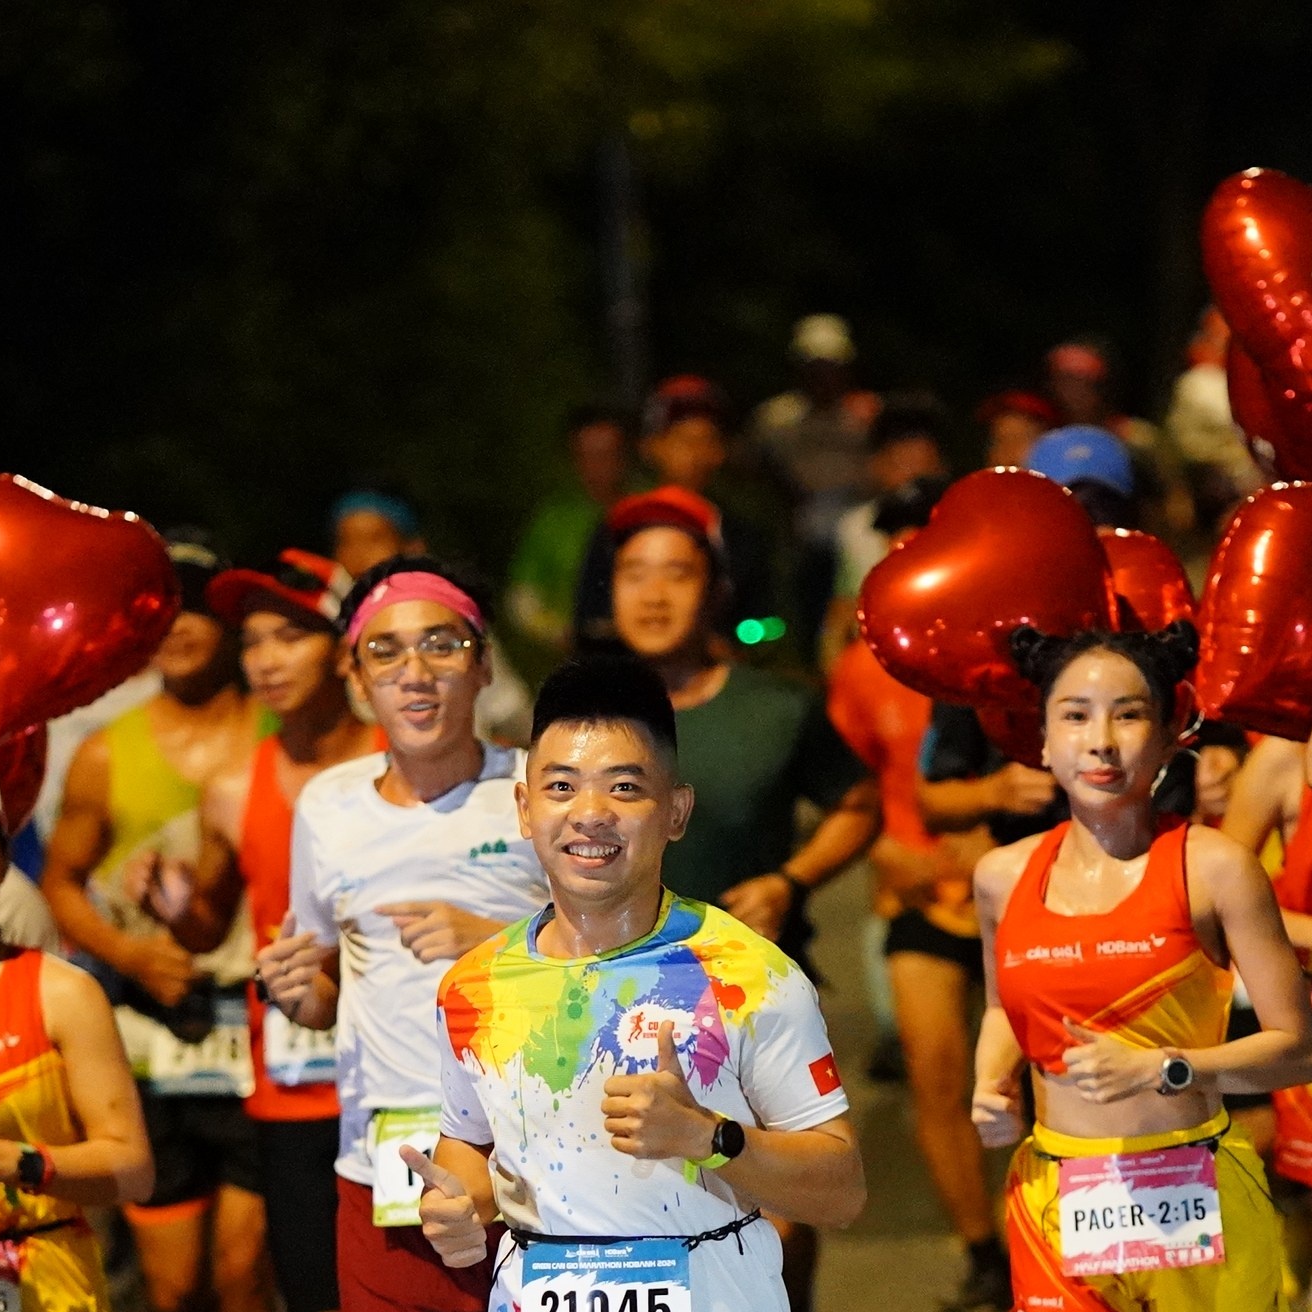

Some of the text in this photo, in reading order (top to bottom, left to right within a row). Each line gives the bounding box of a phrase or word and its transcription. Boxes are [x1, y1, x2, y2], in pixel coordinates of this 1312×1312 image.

[1096, 940, 1152, 955] HDBank
[1074, 1197, 1207, 1232] PACER-2:15
[532, 1262, 552, 1270] GREEN
[552, 1262, 566, 1270] CAN
[579, 1261, 622, 1269] MARATHON
[623, 1260, 656, 1269] HDBANK
[657, 1259, 676, 1267] 2024
